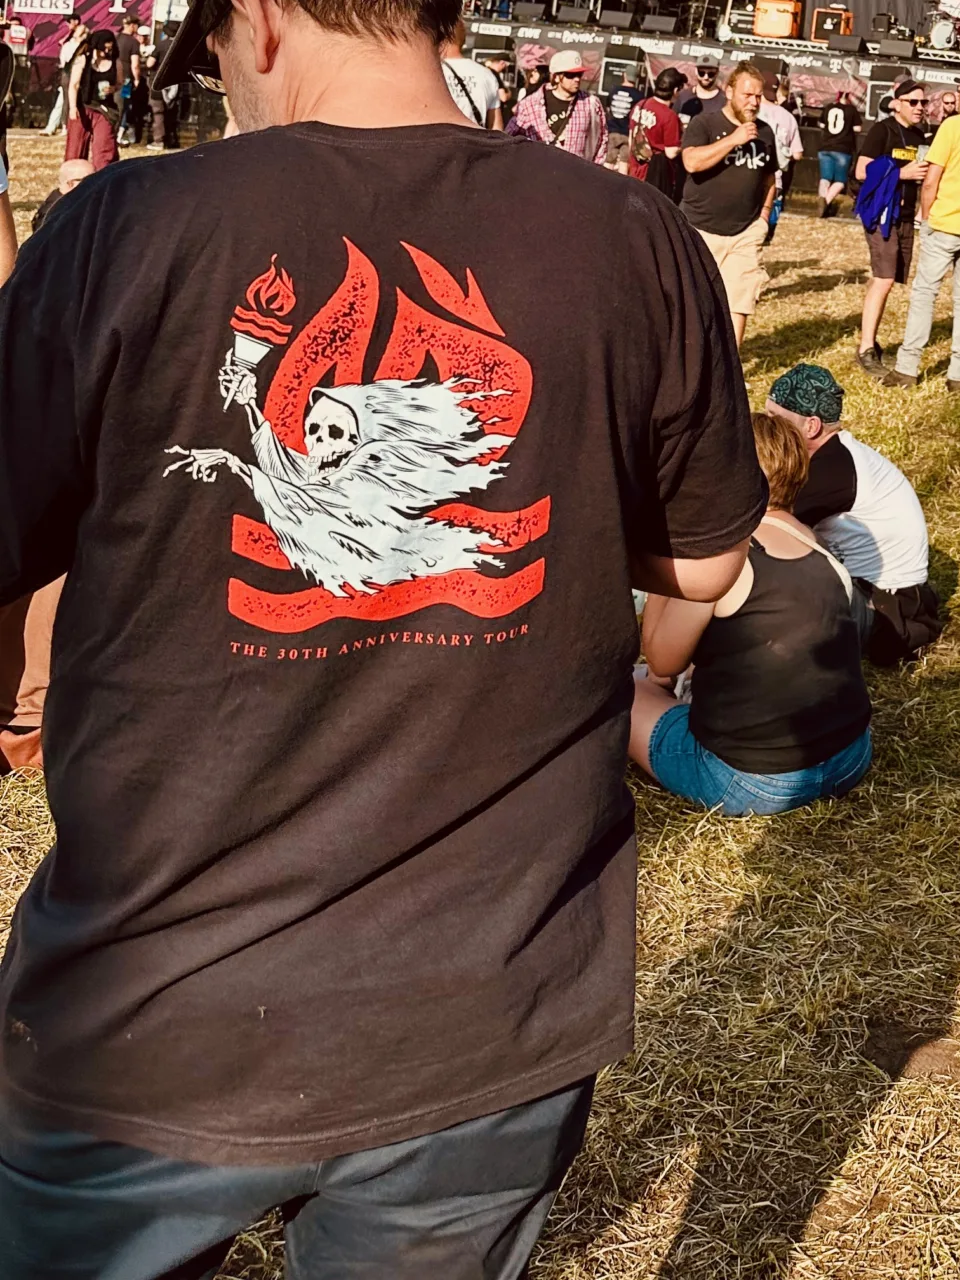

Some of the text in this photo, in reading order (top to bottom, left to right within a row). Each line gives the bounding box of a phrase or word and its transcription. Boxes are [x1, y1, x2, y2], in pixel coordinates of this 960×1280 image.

[230, 624, 530, 659] THE 30TH ANNIVERSARY TOUR
